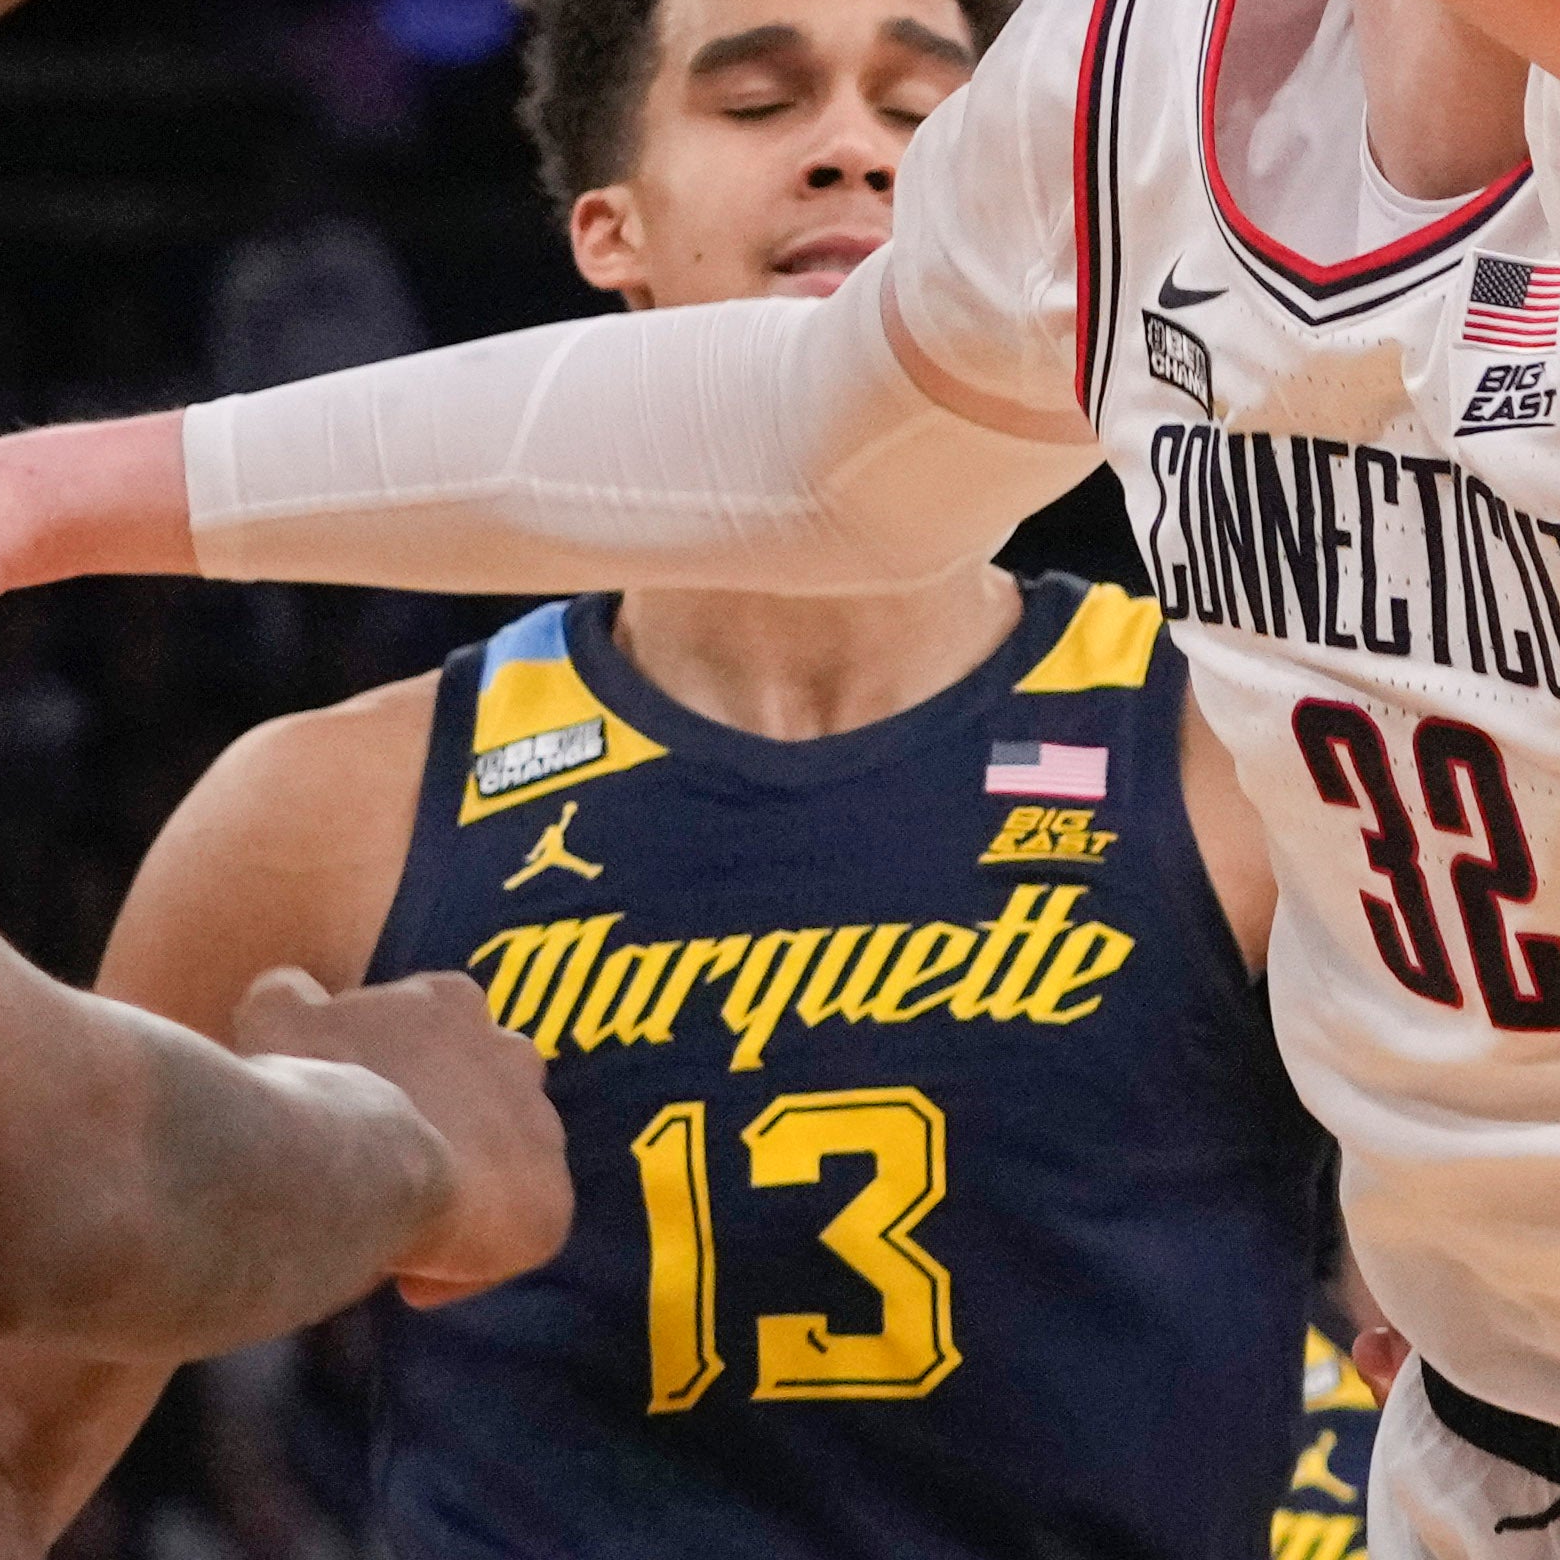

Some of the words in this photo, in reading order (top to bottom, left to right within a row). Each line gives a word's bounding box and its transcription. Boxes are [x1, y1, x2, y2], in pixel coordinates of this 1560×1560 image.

[1476, 362, 1546, 392] BIG
[1461, 389, 1558, 422] EAST
[1003, 805, 1096, 833] BIG
[467, 884, 1135, 1073] Marquette
[631, 1086, 963, 1416] 13
